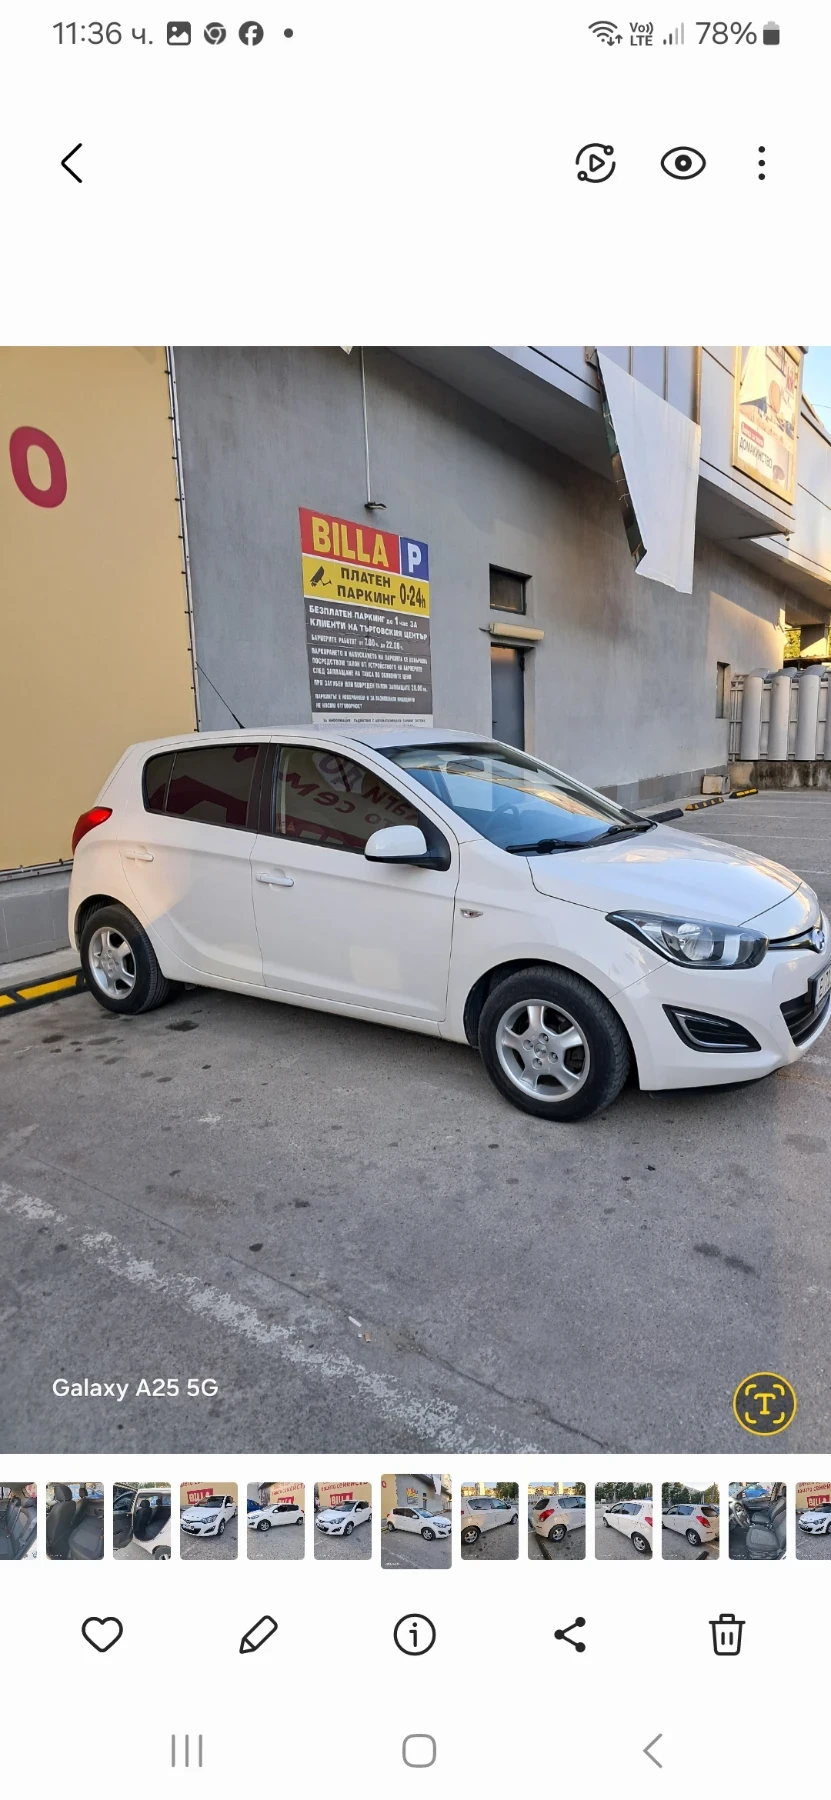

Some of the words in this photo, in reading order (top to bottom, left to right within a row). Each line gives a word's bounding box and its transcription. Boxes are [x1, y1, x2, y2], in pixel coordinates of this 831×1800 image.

[53, 22, 122, 44] 11:36
[630, 35, 653, 46] LTE
[695, 22, 757, 45] 78%
[312, 516, 389, 567] BILLA
[407, 542, 422, 573] P
[340, 567, 391, 589] ПЛАТЕН
[337, 584, 396, 606] ПАРКИНГ
[309, 605, 353, 619] БЕЗПЛАТЕН
[354, 611, 386, 623] ПАРКИНГ
[394, 616, 399, 626] 1
[310, 618, 346, 630] КЛИЕНТИ
[348, 623, 358, 632] НА
[359, 624, 402, 637] ТЪРГОВСКИЯ
[404, 631, 428, 640] ЦЕНТЪР
